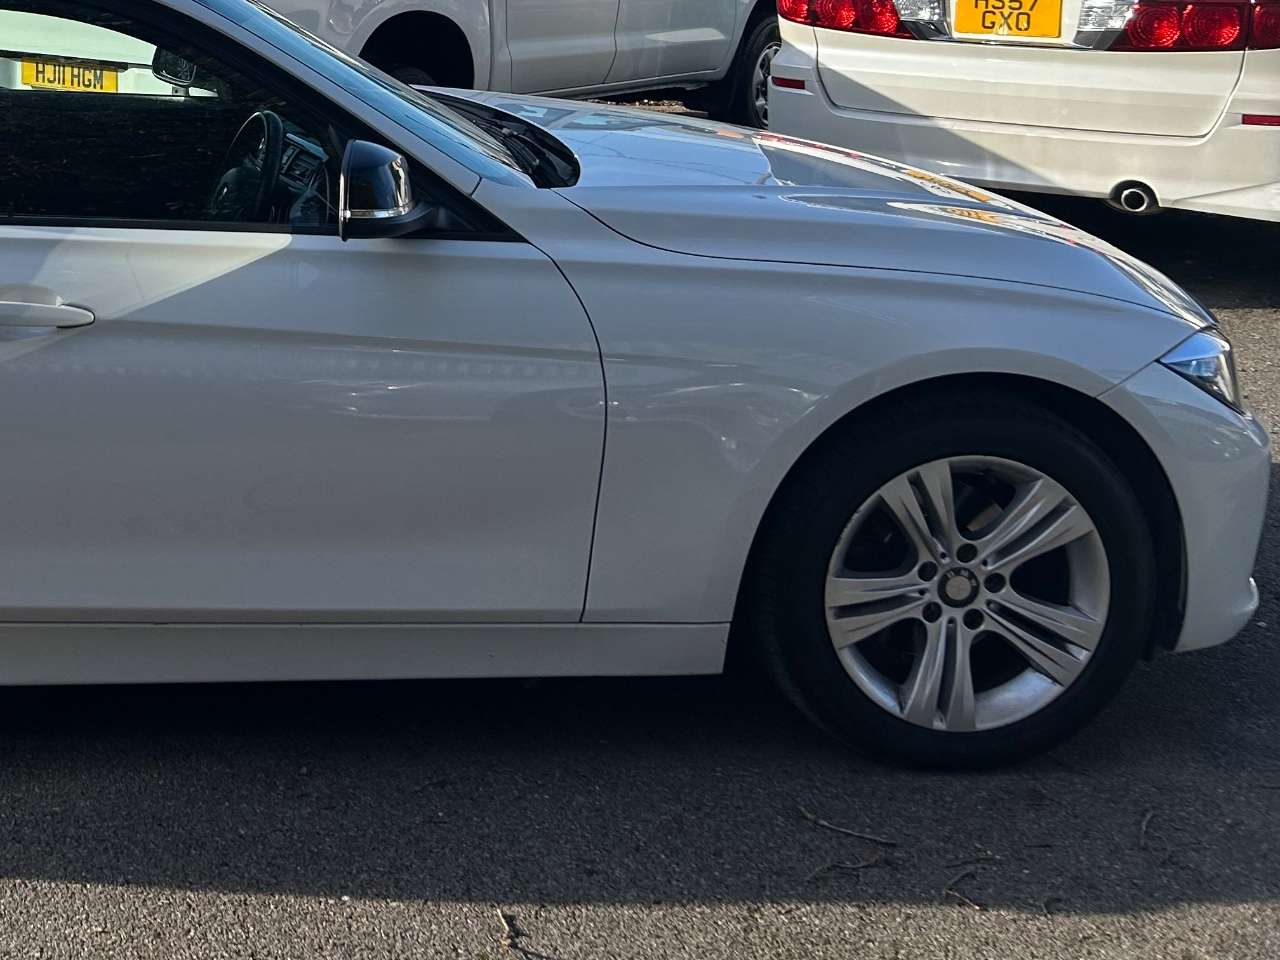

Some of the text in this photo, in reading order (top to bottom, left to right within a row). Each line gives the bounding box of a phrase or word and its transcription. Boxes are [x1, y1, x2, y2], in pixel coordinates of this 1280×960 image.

[981, 10, 1031, 32] GXO
[35, 62, 104, 90] HJ11 HGM
